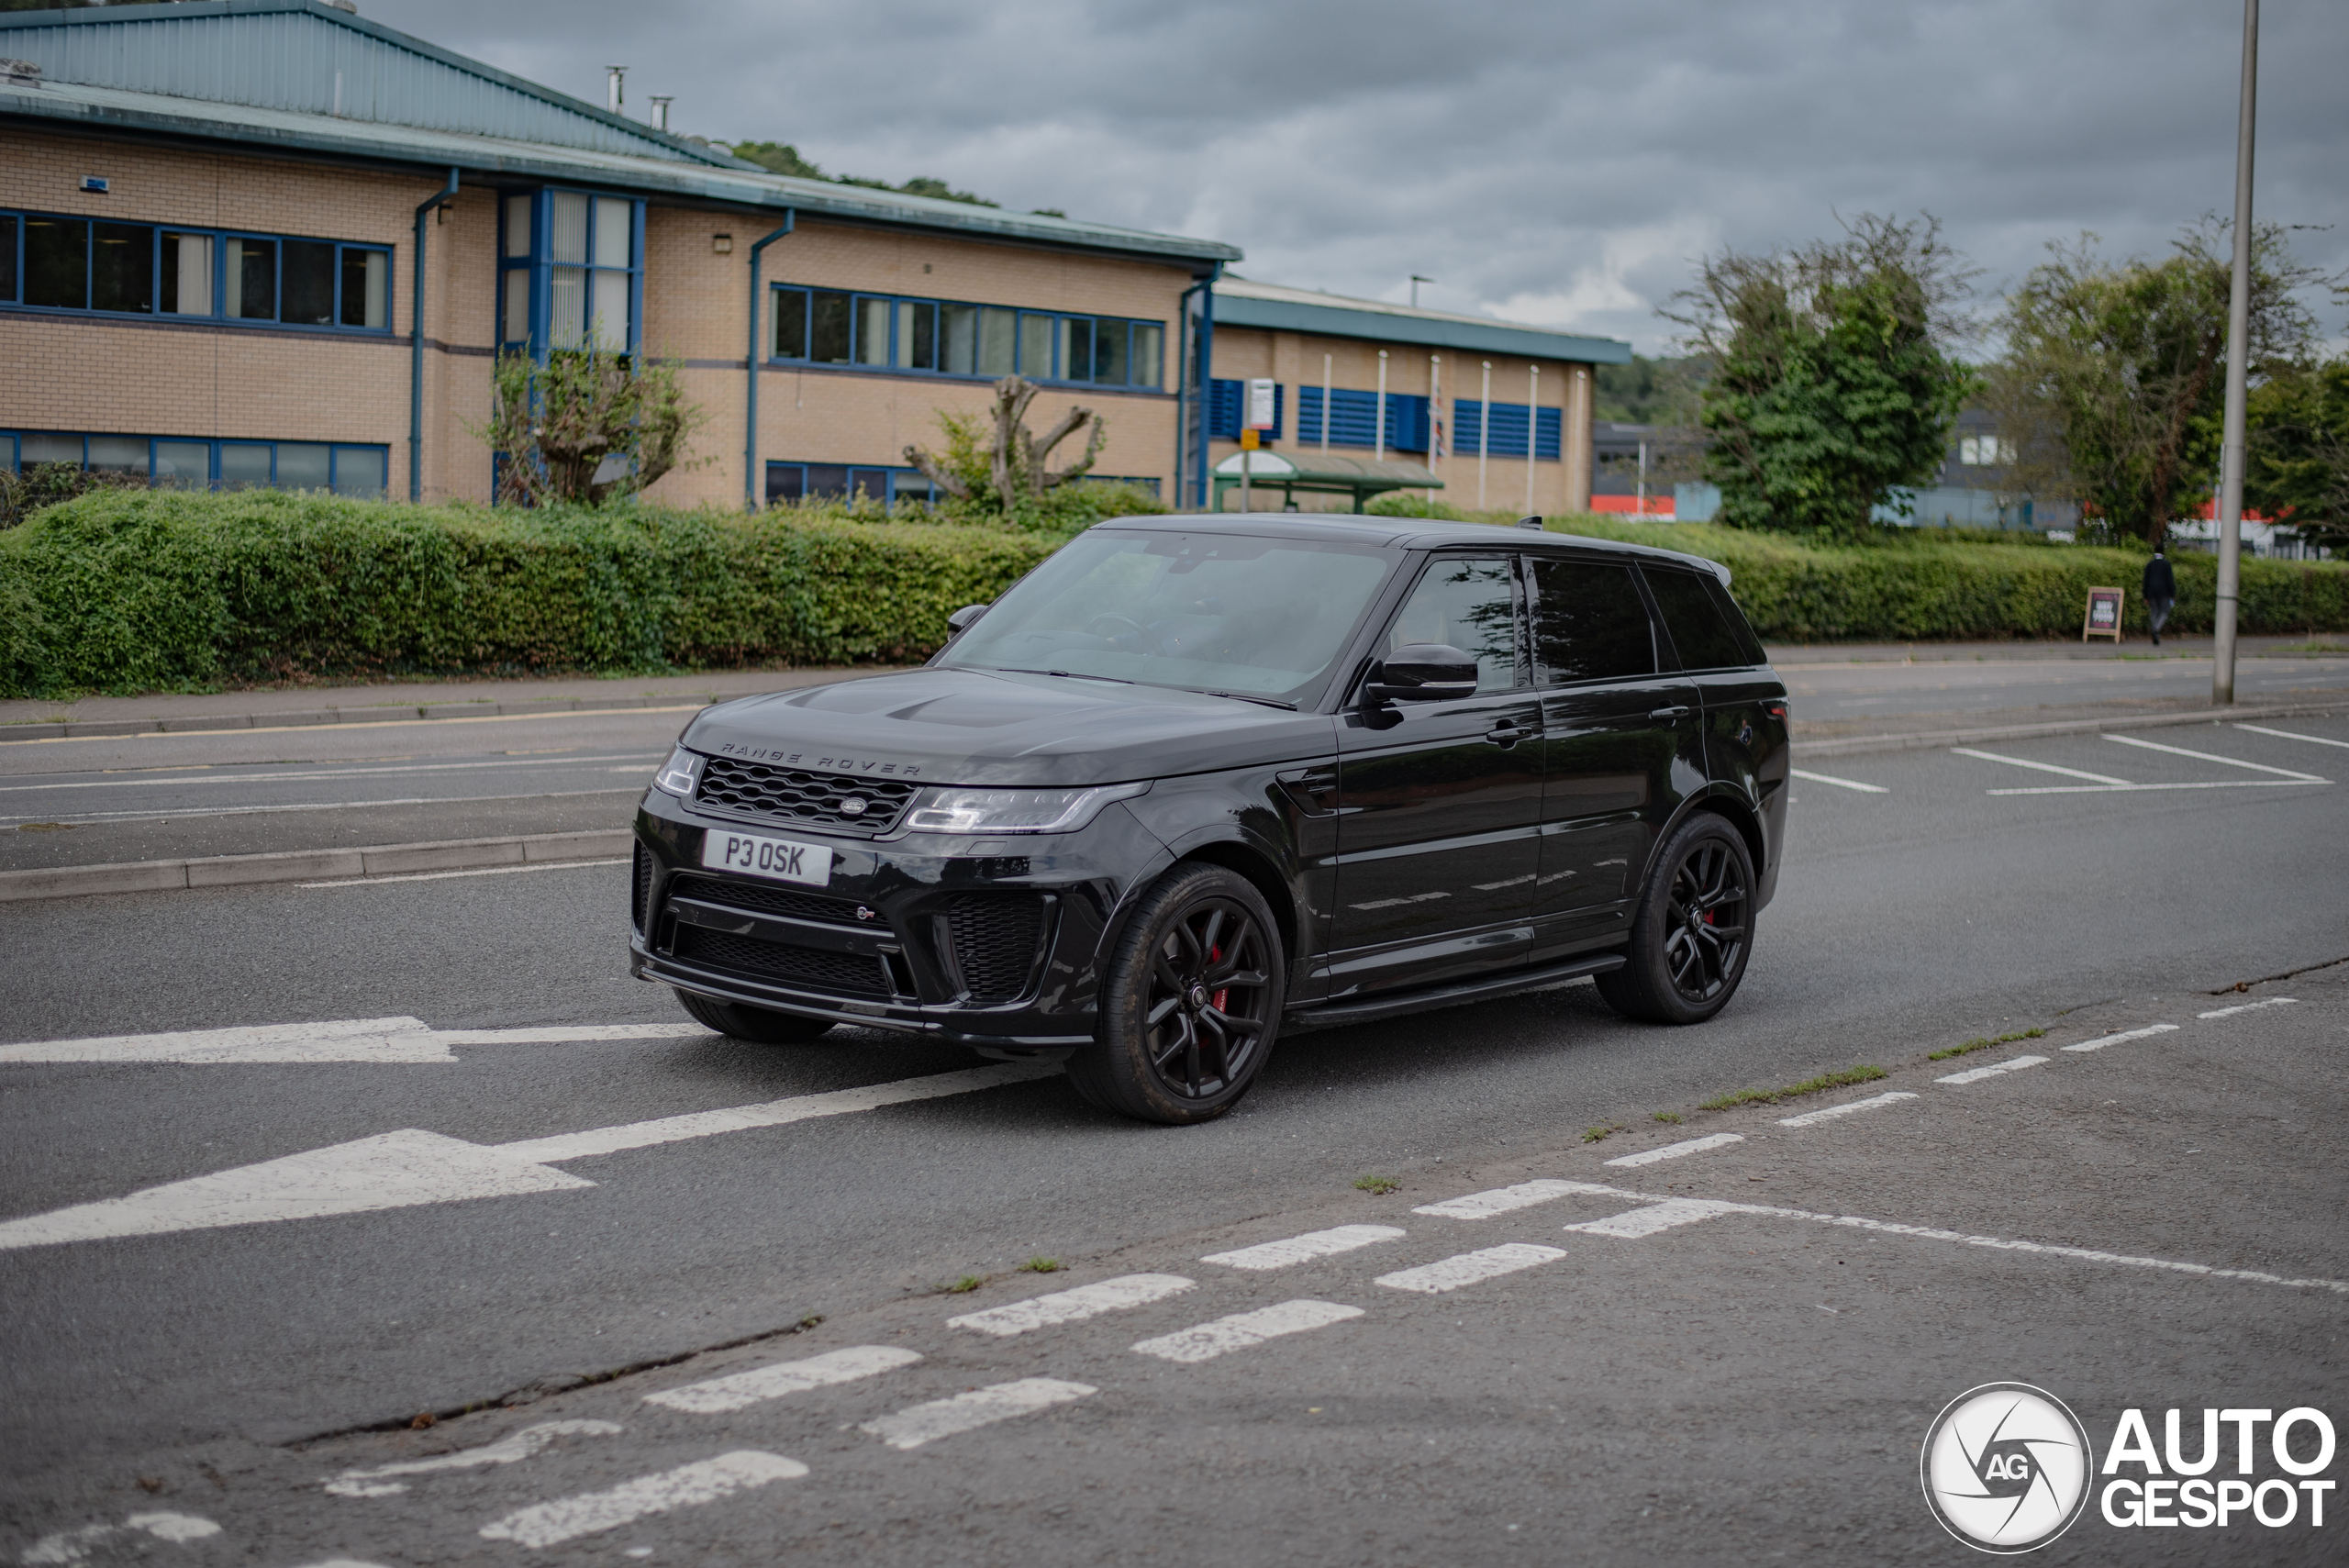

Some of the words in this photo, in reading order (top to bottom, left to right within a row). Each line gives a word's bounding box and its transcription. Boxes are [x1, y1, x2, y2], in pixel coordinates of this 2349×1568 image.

[720, 742, 803, 763] RANGE
[817, 757, 920, 776] ROVER
[725, 837, 754, 867] P3
